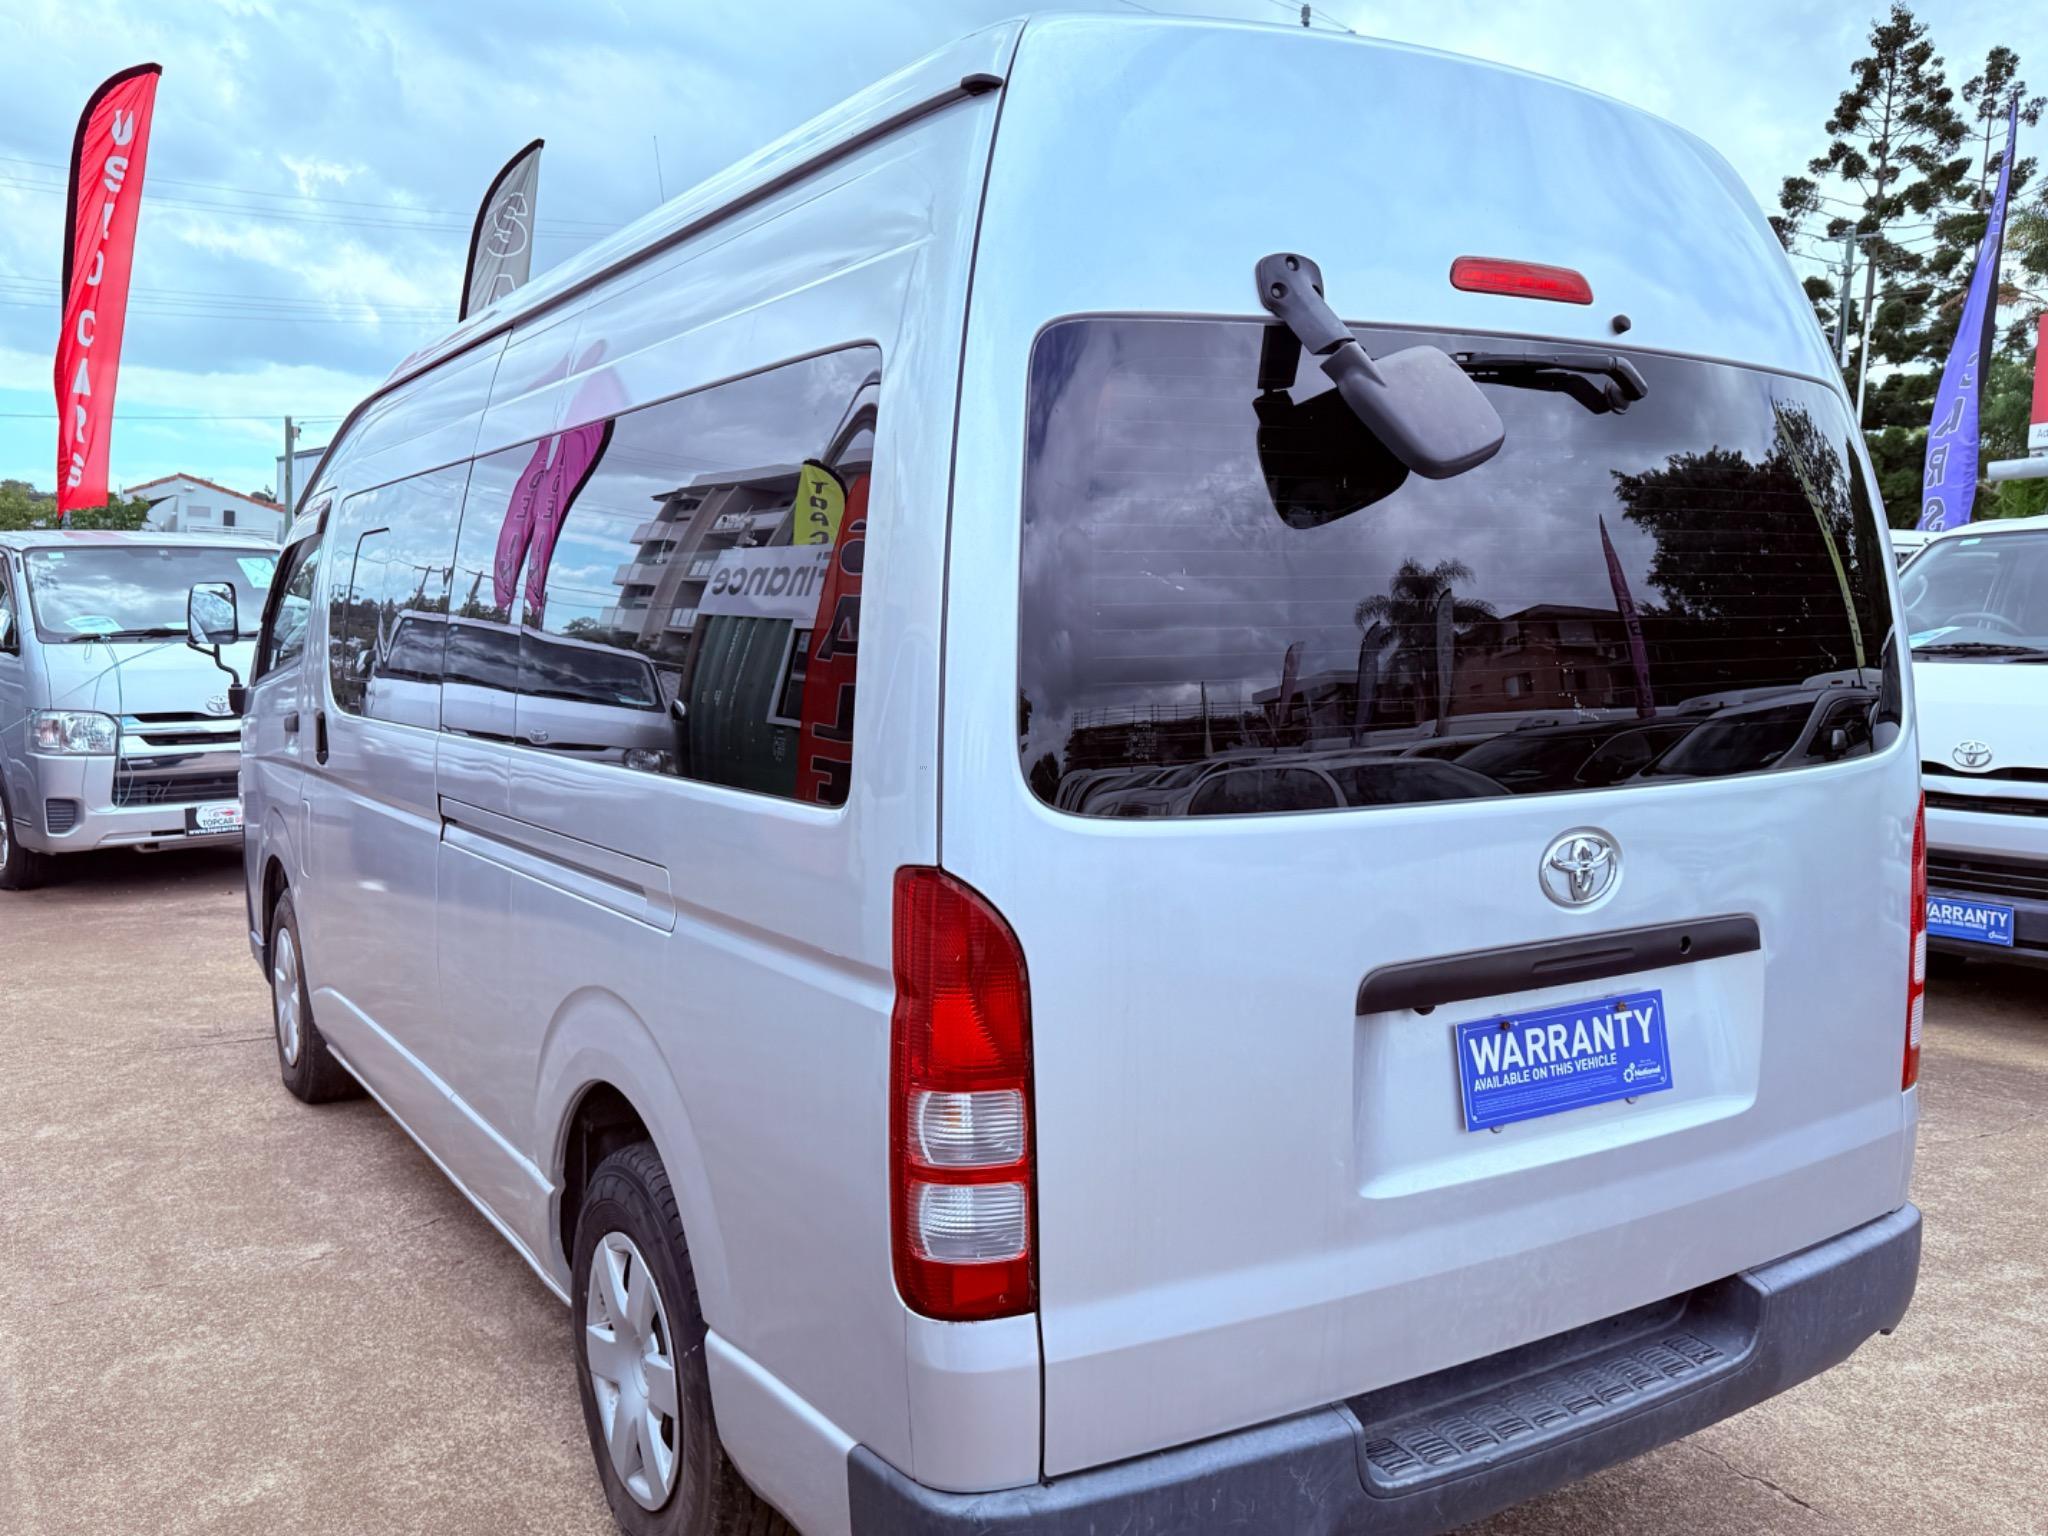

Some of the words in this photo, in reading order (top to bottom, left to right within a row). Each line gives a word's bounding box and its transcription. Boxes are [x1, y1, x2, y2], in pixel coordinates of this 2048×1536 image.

[67, 309, 97, 489] CARS
[1469, 1007, 1653, 1075] WARRANTY
[1473, 1069, 1531, 1092] AVAILABLE
[1532, 1065, 1548, 1080] ON
[1549, 1062, 1574, 1076] THIS
[1574, 1052, 1618, 1072] VEHICLE
